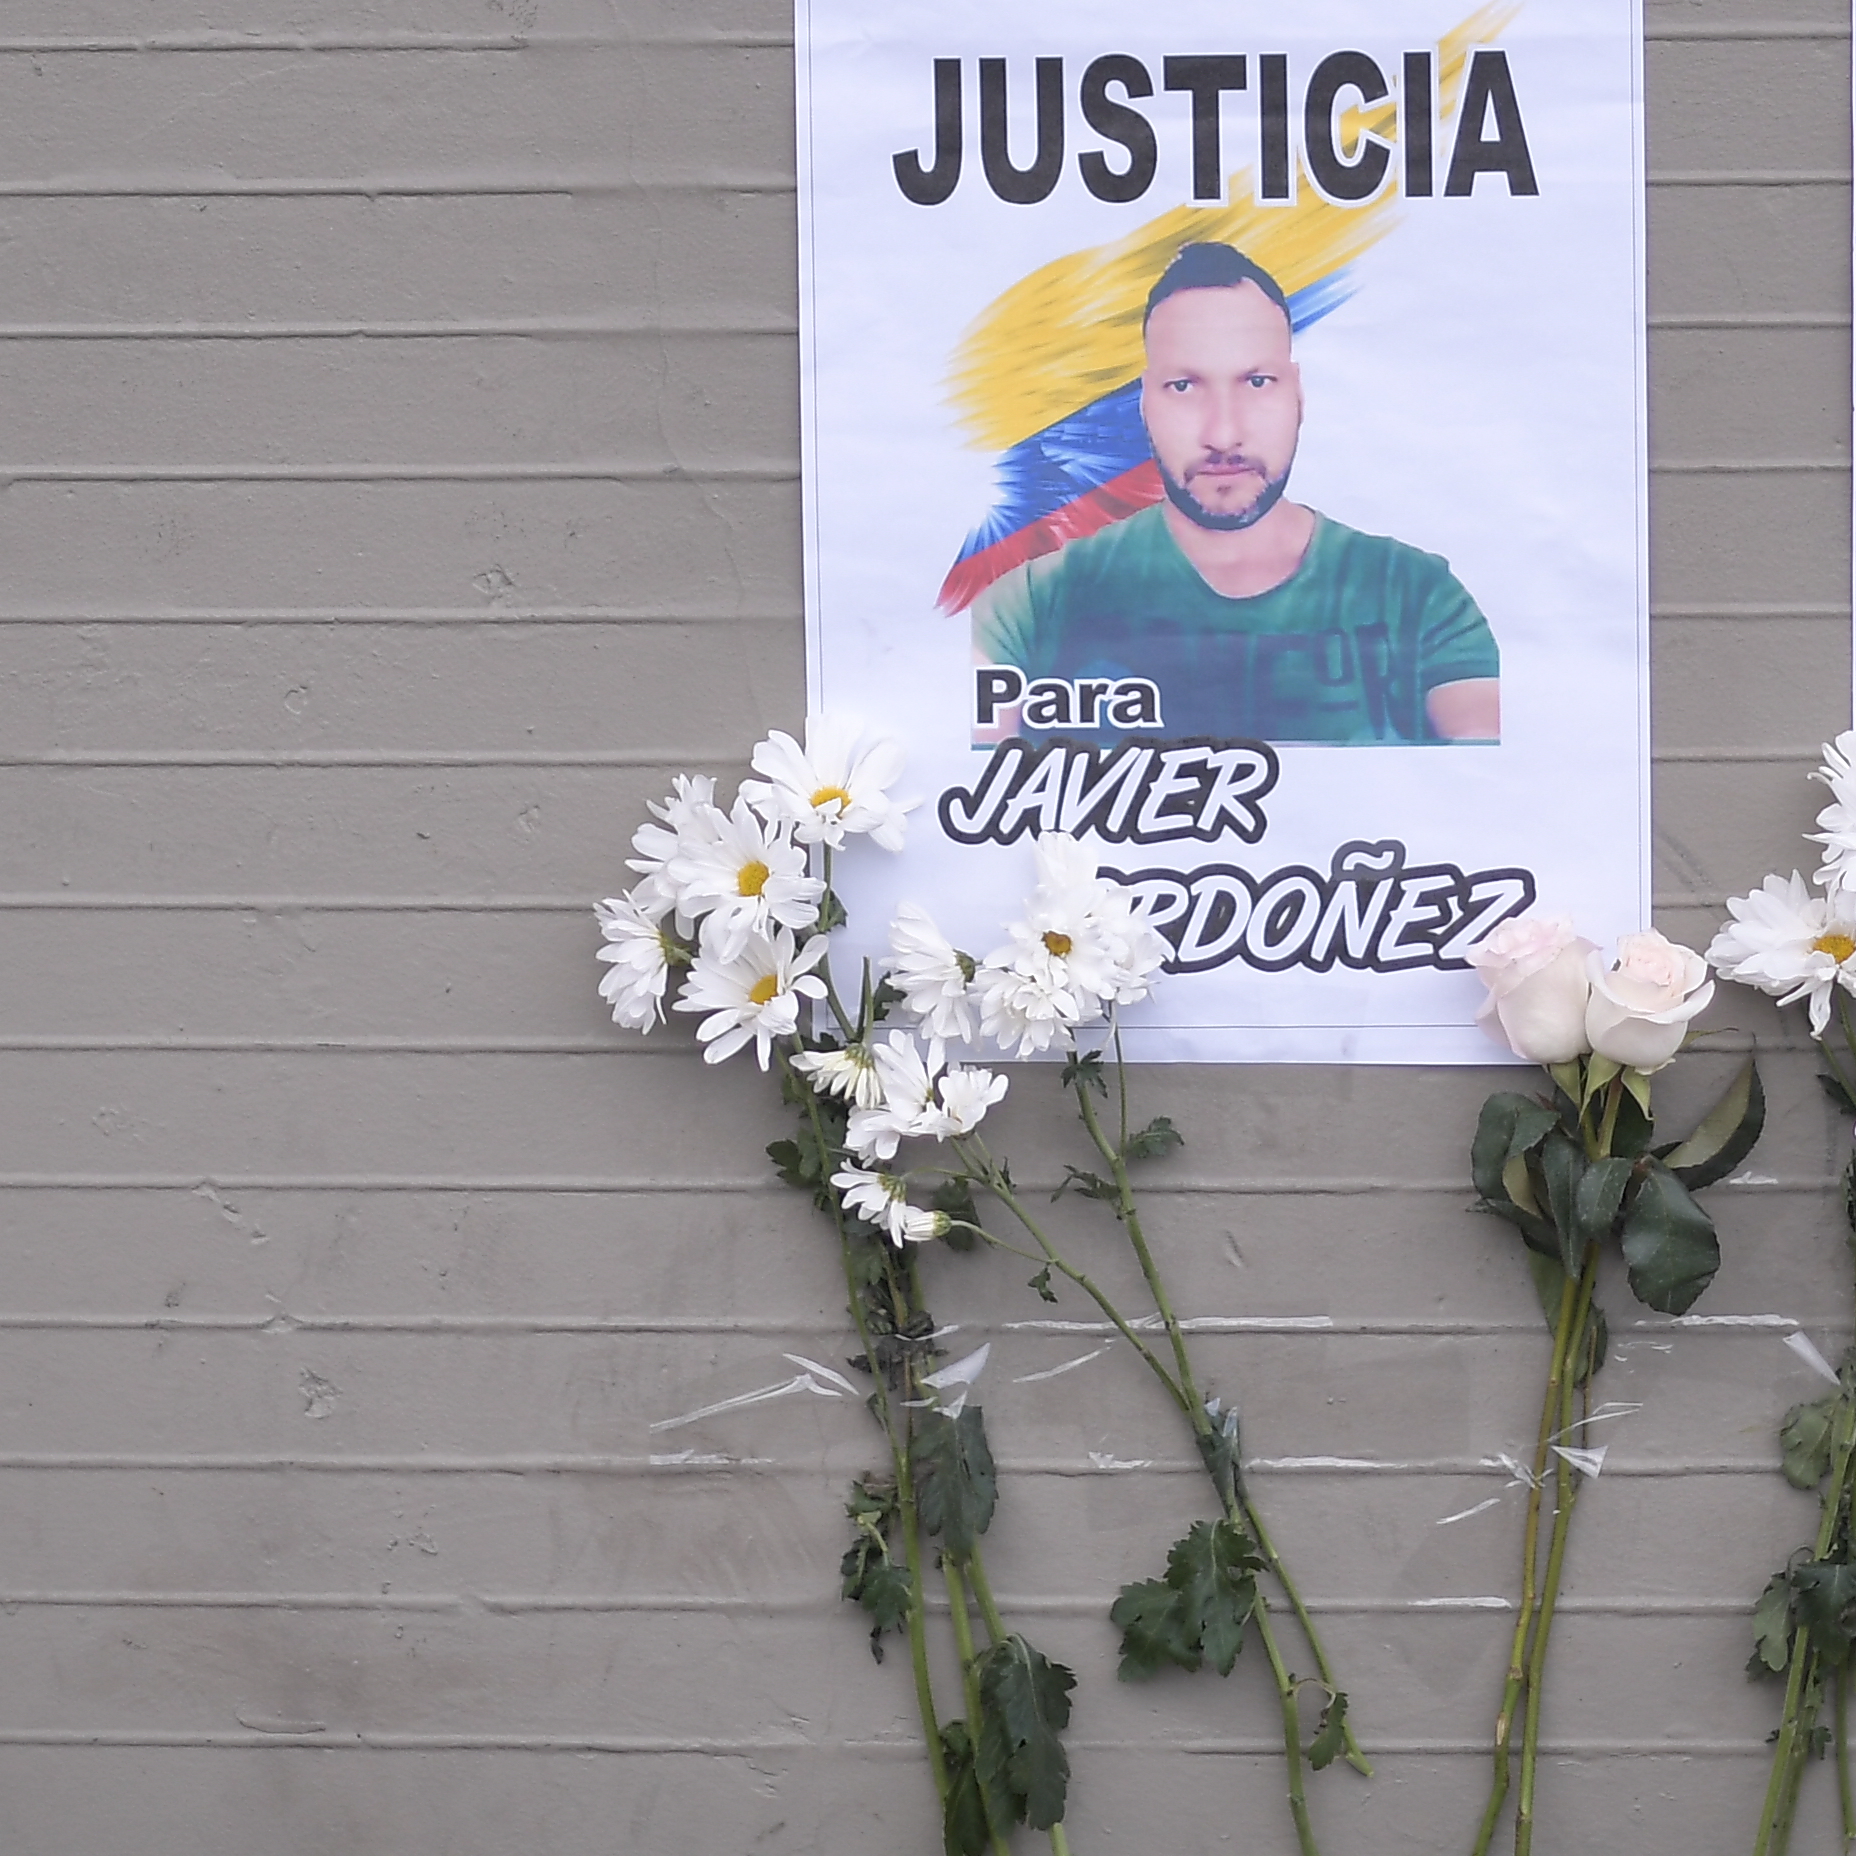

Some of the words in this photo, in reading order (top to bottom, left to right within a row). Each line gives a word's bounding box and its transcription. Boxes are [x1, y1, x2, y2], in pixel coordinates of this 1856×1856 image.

[892, 50, 1540, 205] JUSTICIA
[974, 667, 1163, 727] Para
[940, 736, 1279, 844] JAVIER
[1095, 841, 1535, 972] RDOÑEZ
